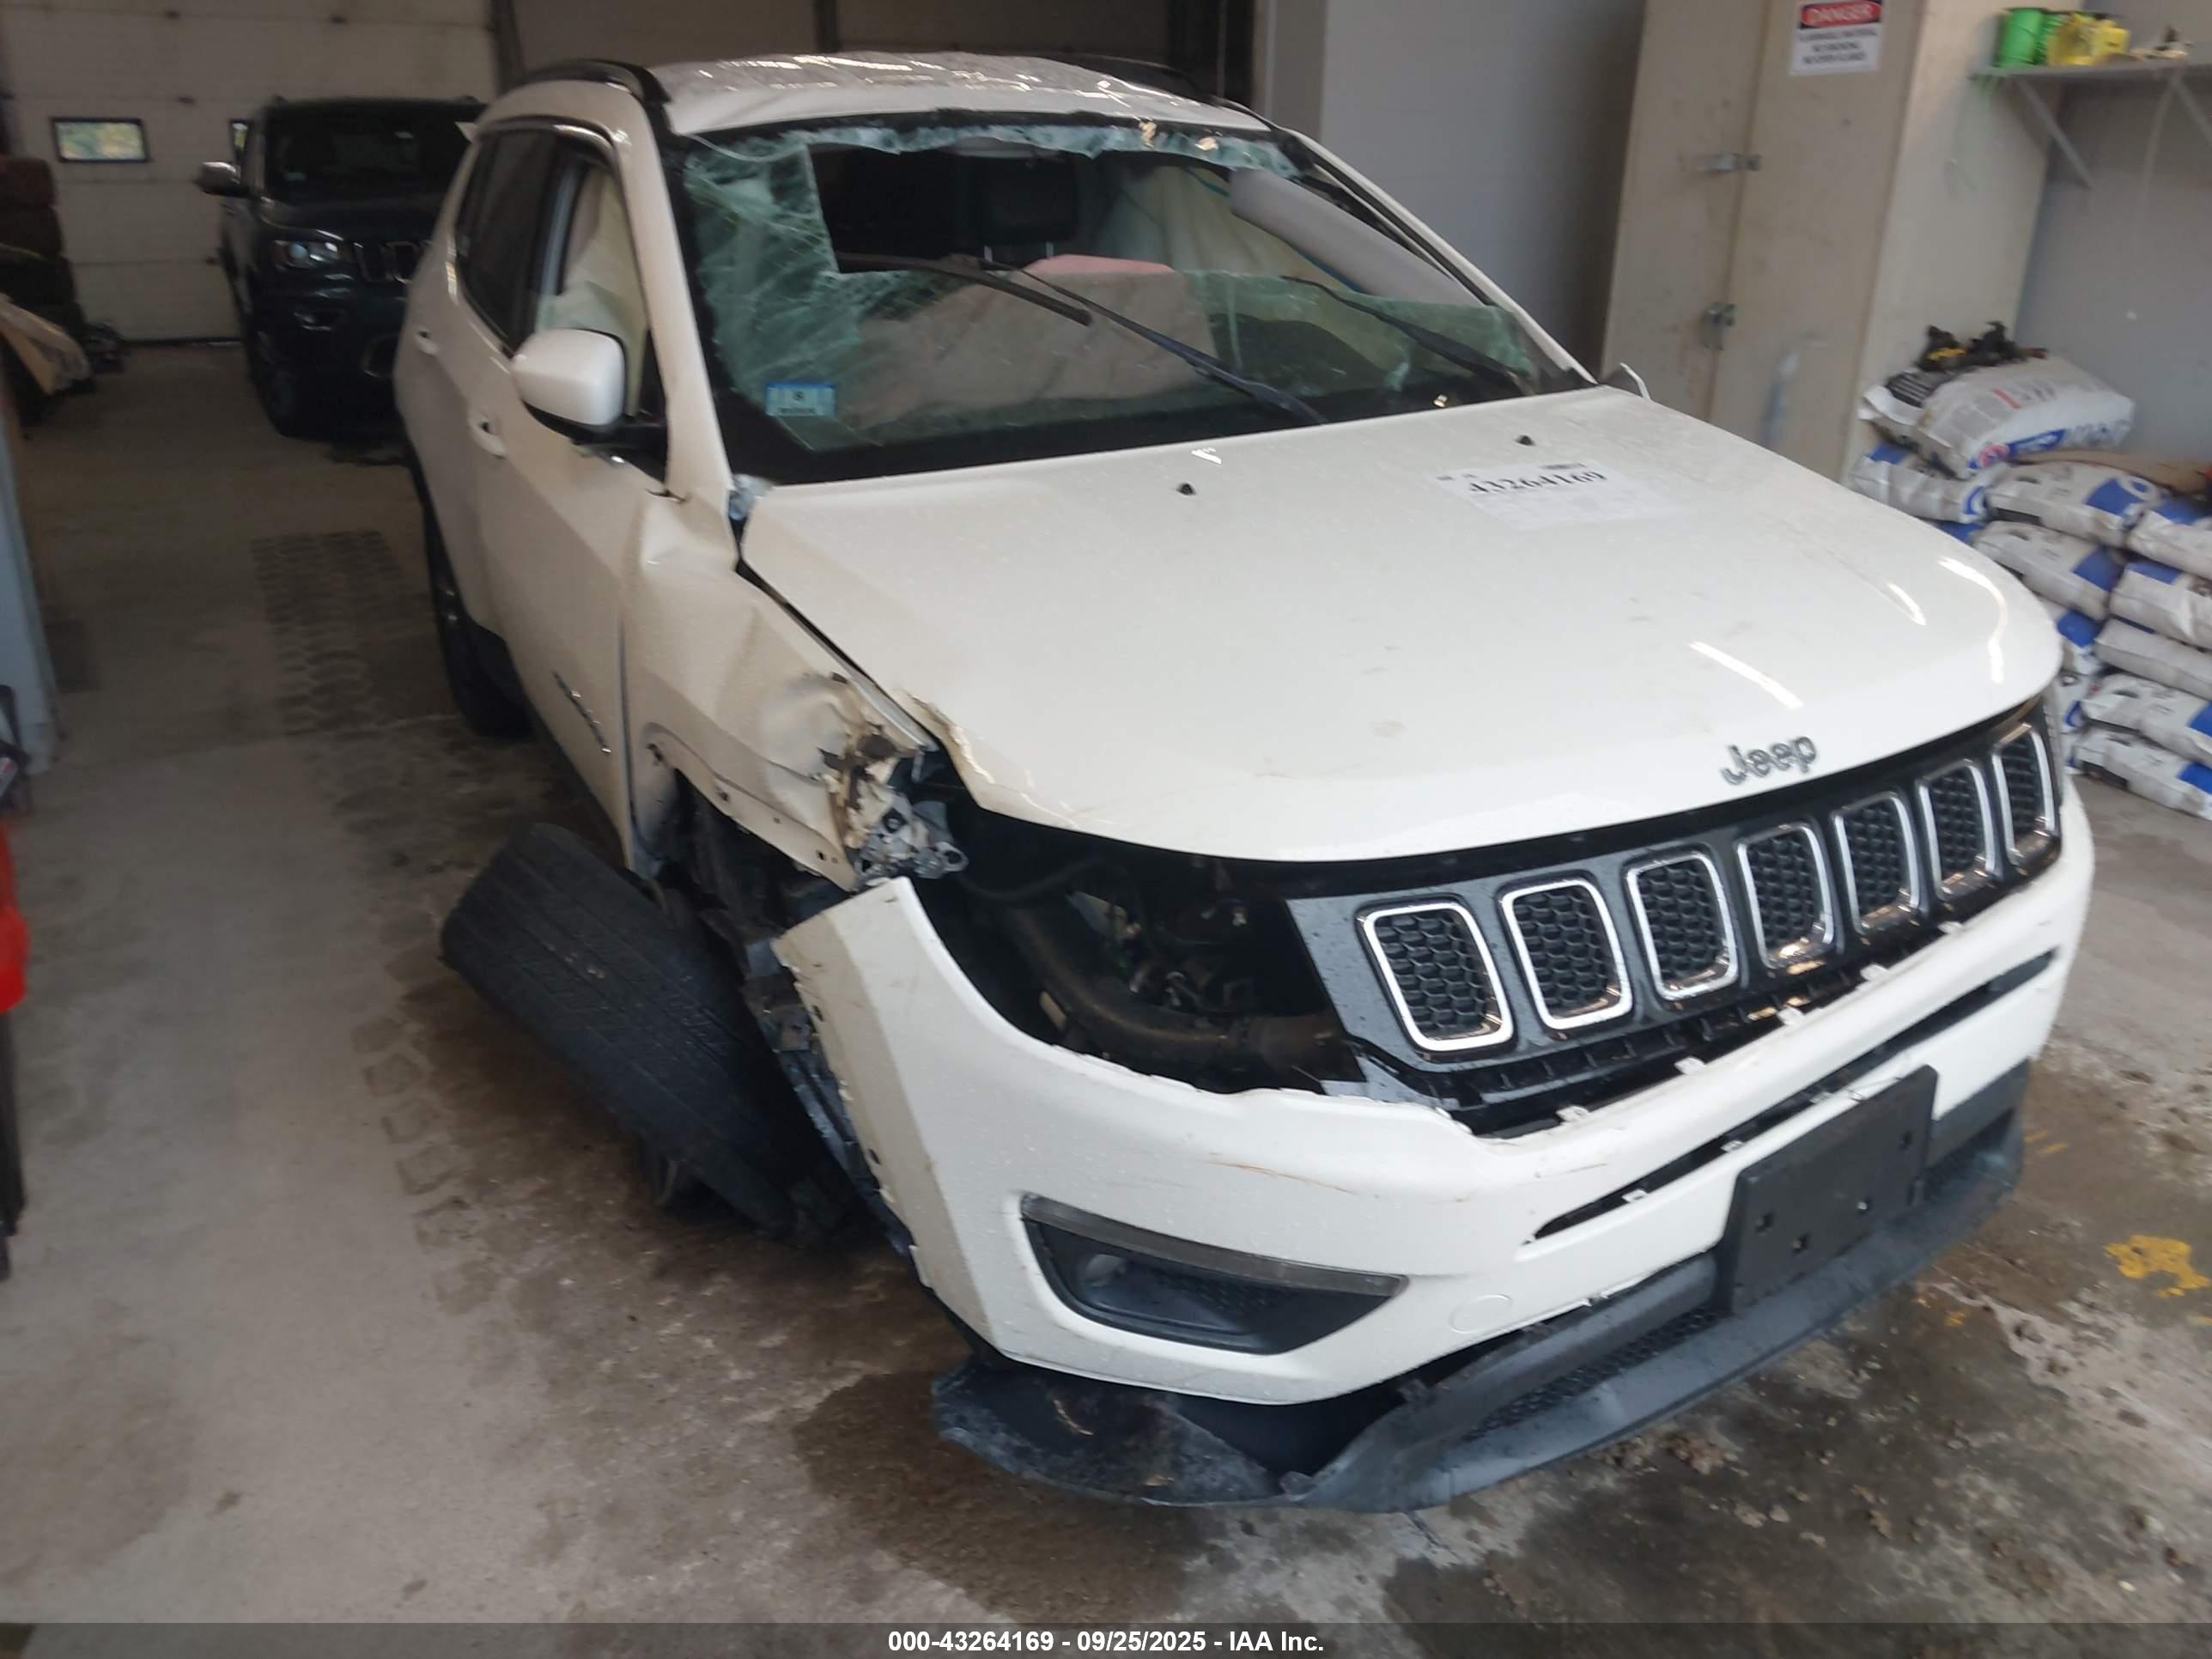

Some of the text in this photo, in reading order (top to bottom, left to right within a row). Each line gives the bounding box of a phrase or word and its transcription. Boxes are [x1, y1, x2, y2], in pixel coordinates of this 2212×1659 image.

[1806, 4, 1871, 25] DANGER
[1469, 470, 1607, 494] 43264169
[1720, 735, 1817, 786] Jeep
